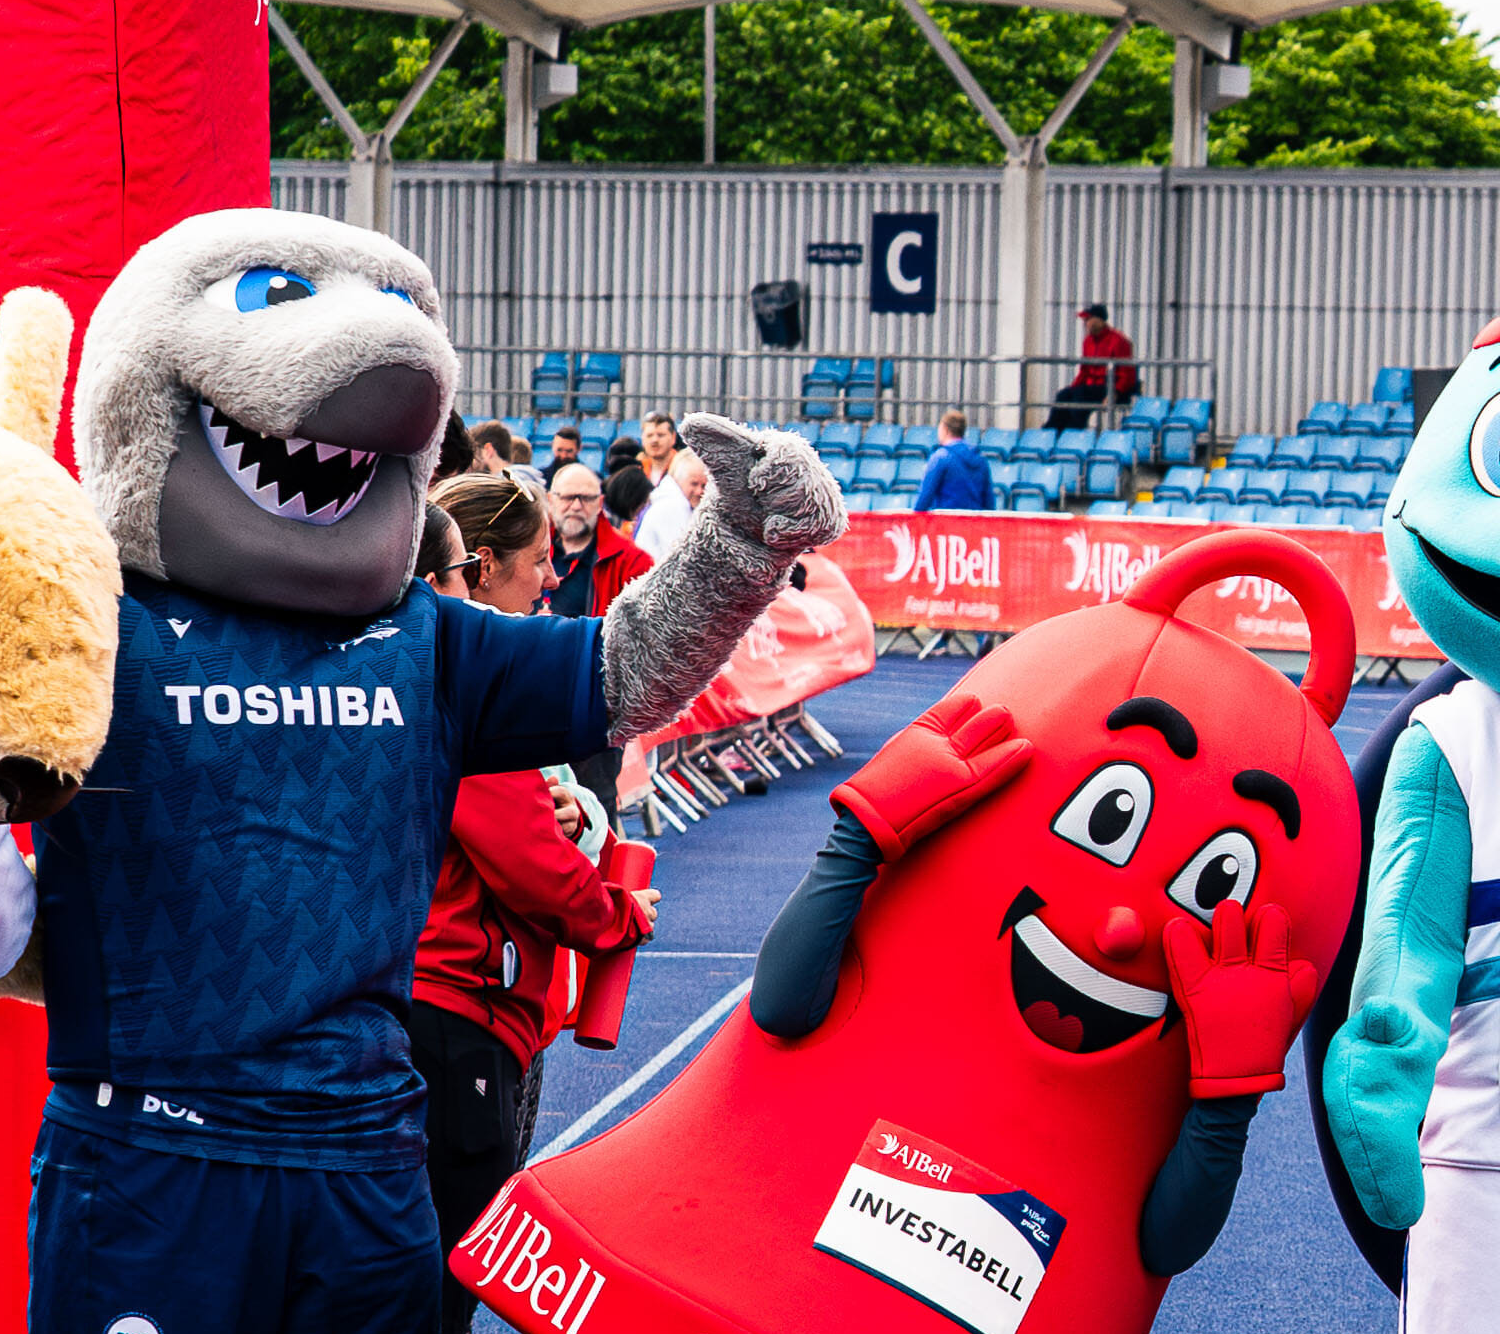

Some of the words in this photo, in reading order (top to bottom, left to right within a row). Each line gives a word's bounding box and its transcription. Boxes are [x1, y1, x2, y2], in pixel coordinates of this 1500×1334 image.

[886, 230, 922, 294] C
[911, 534, 1001, 595] AJBell
[165, 685, 405, 726] TOSHIBA
[892, 1144, 953, 1184] AJBell
[849, 1187, 1024, 1301] INVESTABELL
